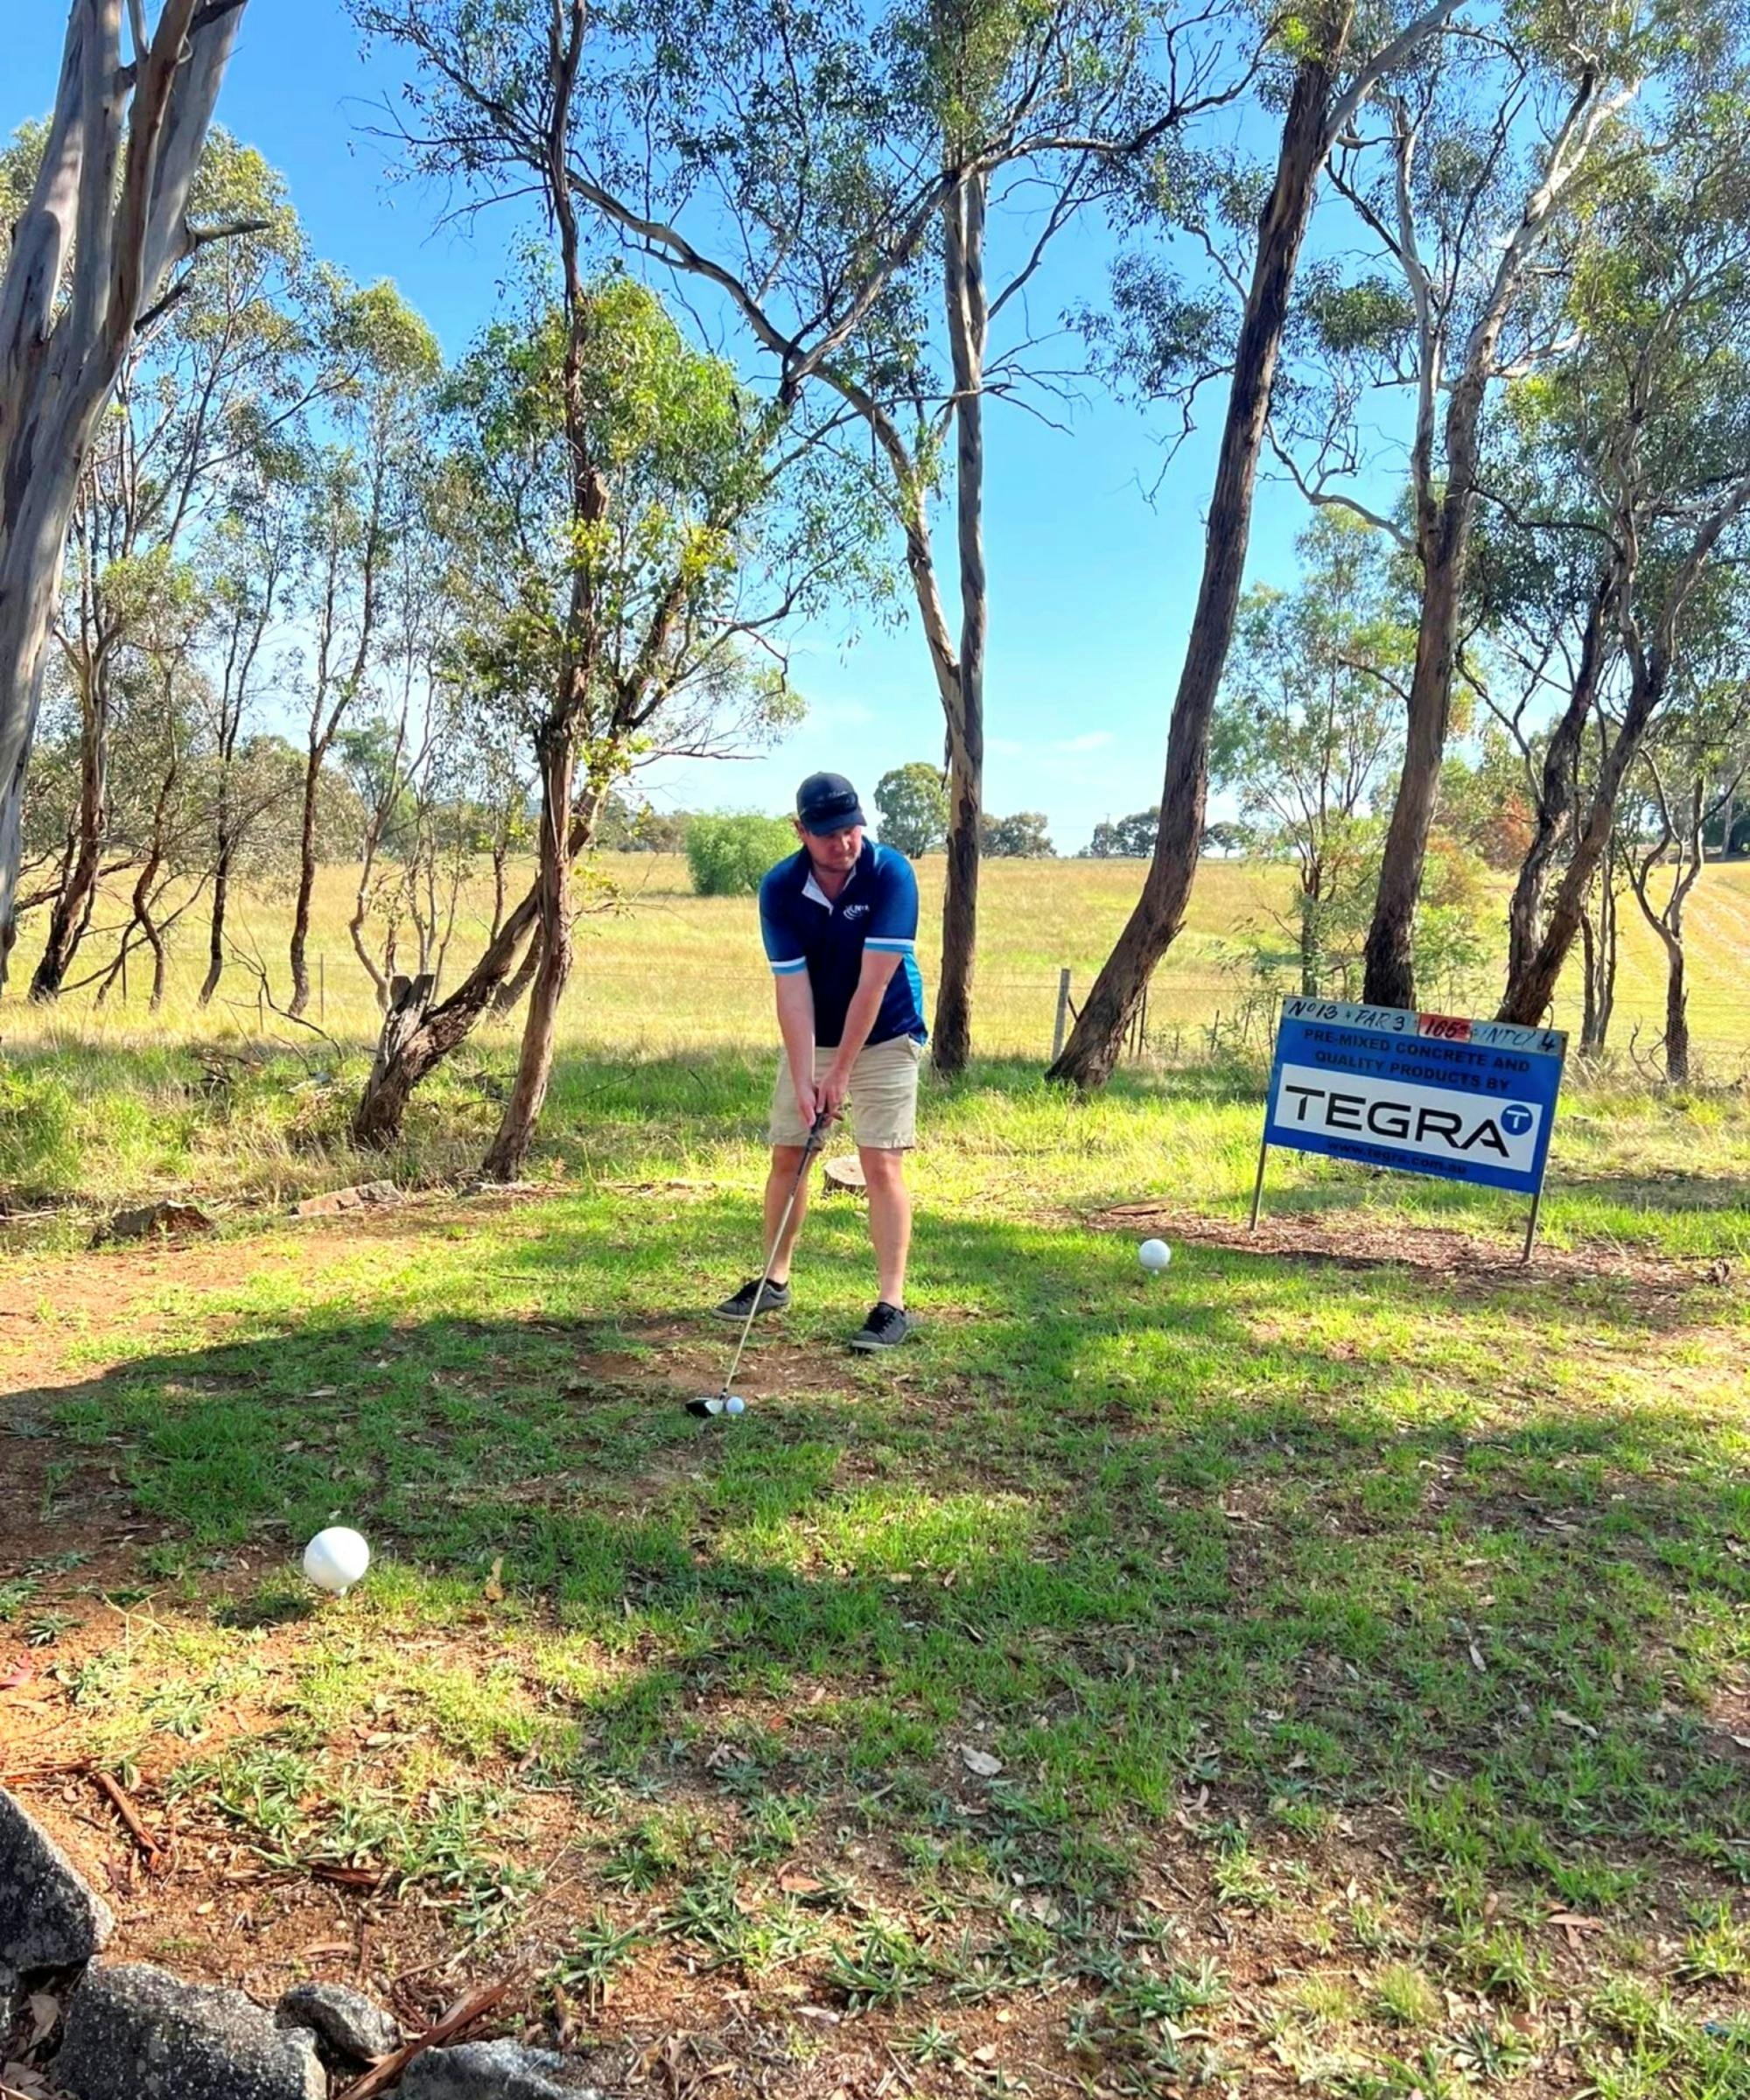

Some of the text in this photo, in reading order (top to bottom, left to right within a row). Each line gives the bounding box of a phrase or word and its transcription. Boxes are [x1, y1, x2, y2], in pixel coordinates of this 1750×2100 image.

[1304, 1028, 1530, 1073] PRE-MIXED CONCRETE AND
[1354, 1009, 1390, 1031] PAR
[1392, 1016, 1405, 1032] 3
[1540, 1031, 1555, 1052] 4
[1314, 1050, 1511, 1091] QUALITY PRODUCTS BY
[1285, 1085, 1510, 1158] TEGRA
[1505, 1109, 1530, 1129] T
[1327, 1141, 1468, 1174] www.tegra.com.au
